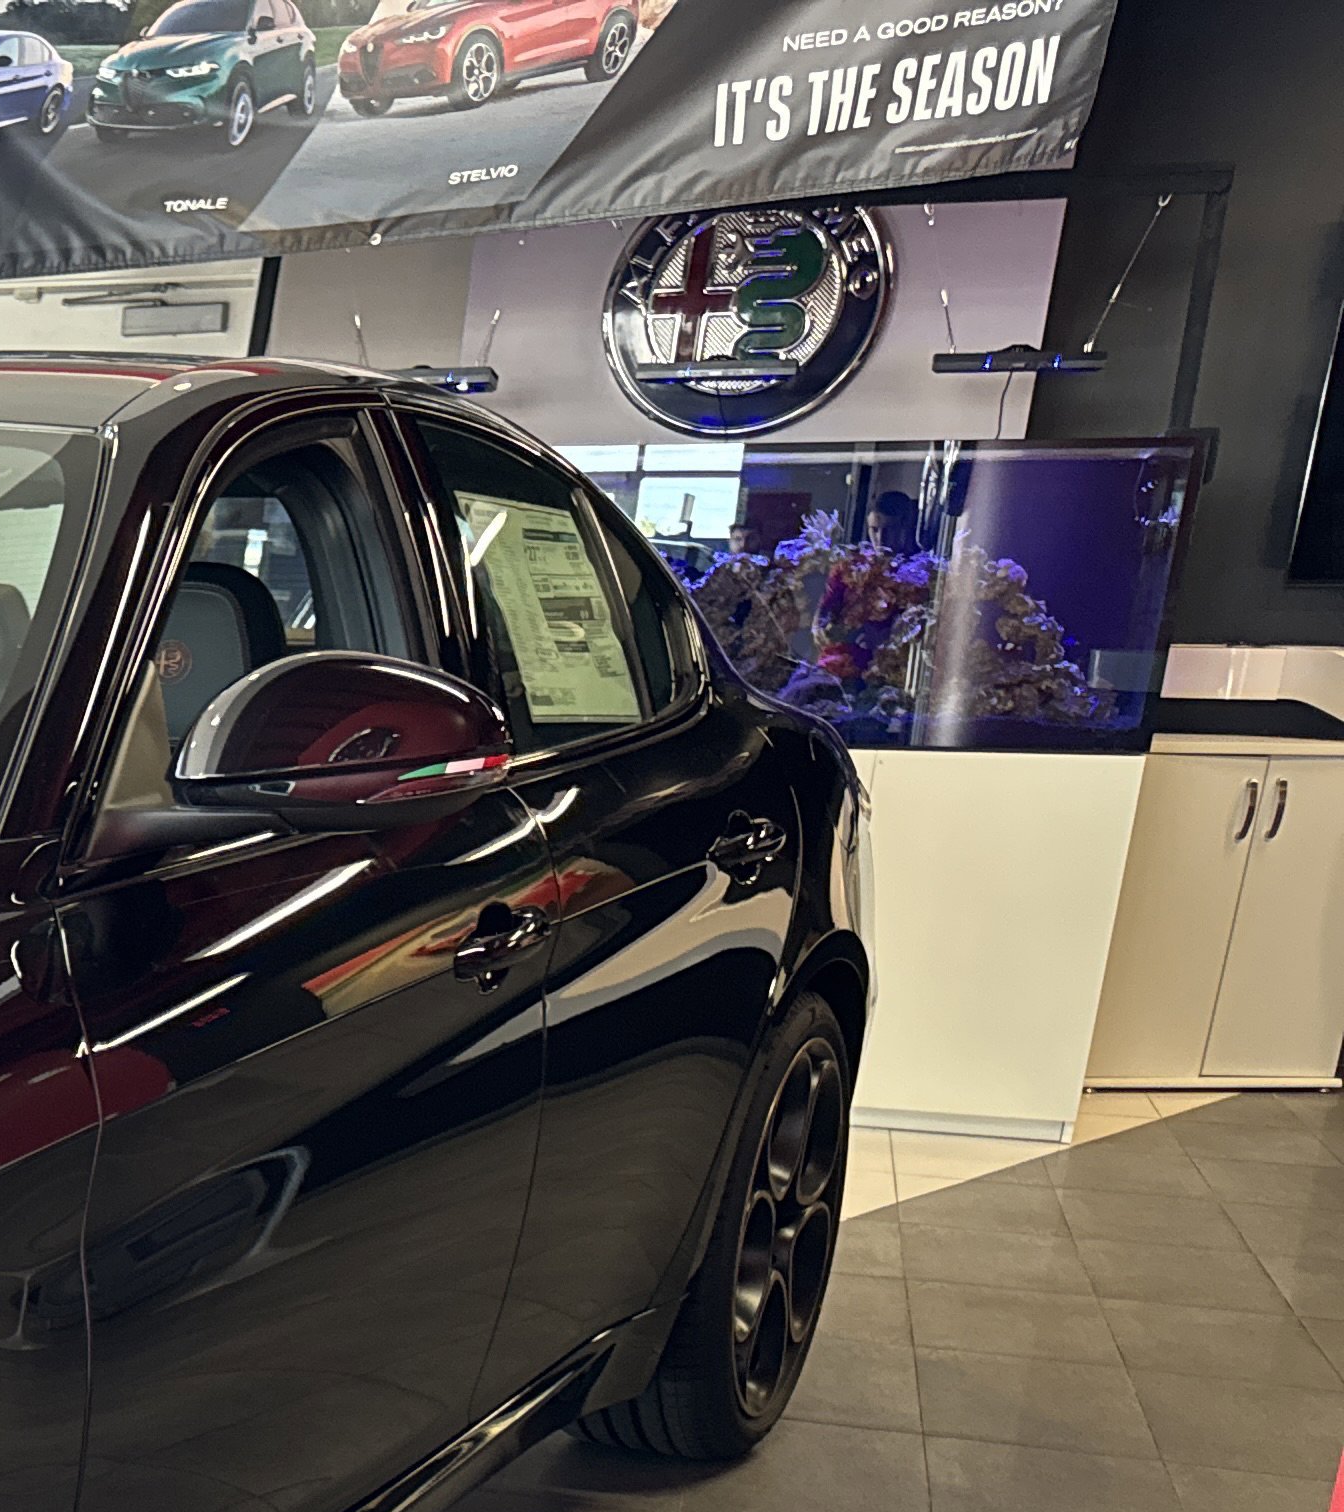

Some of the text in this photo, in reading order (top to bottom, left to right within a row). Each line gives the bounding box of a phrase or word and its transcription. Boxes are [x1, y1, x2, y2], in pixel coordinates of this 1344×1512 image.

[782, 28, 848, 52] NEED
[852, 25, 871, 43] A
[877, 14, 948, 39] GOOD
[713, 35, 1061, 147] IT'S THE SEASON
[448, 164, 519, 185] STELVIO
[163, 197, 229, 213] TONALE
